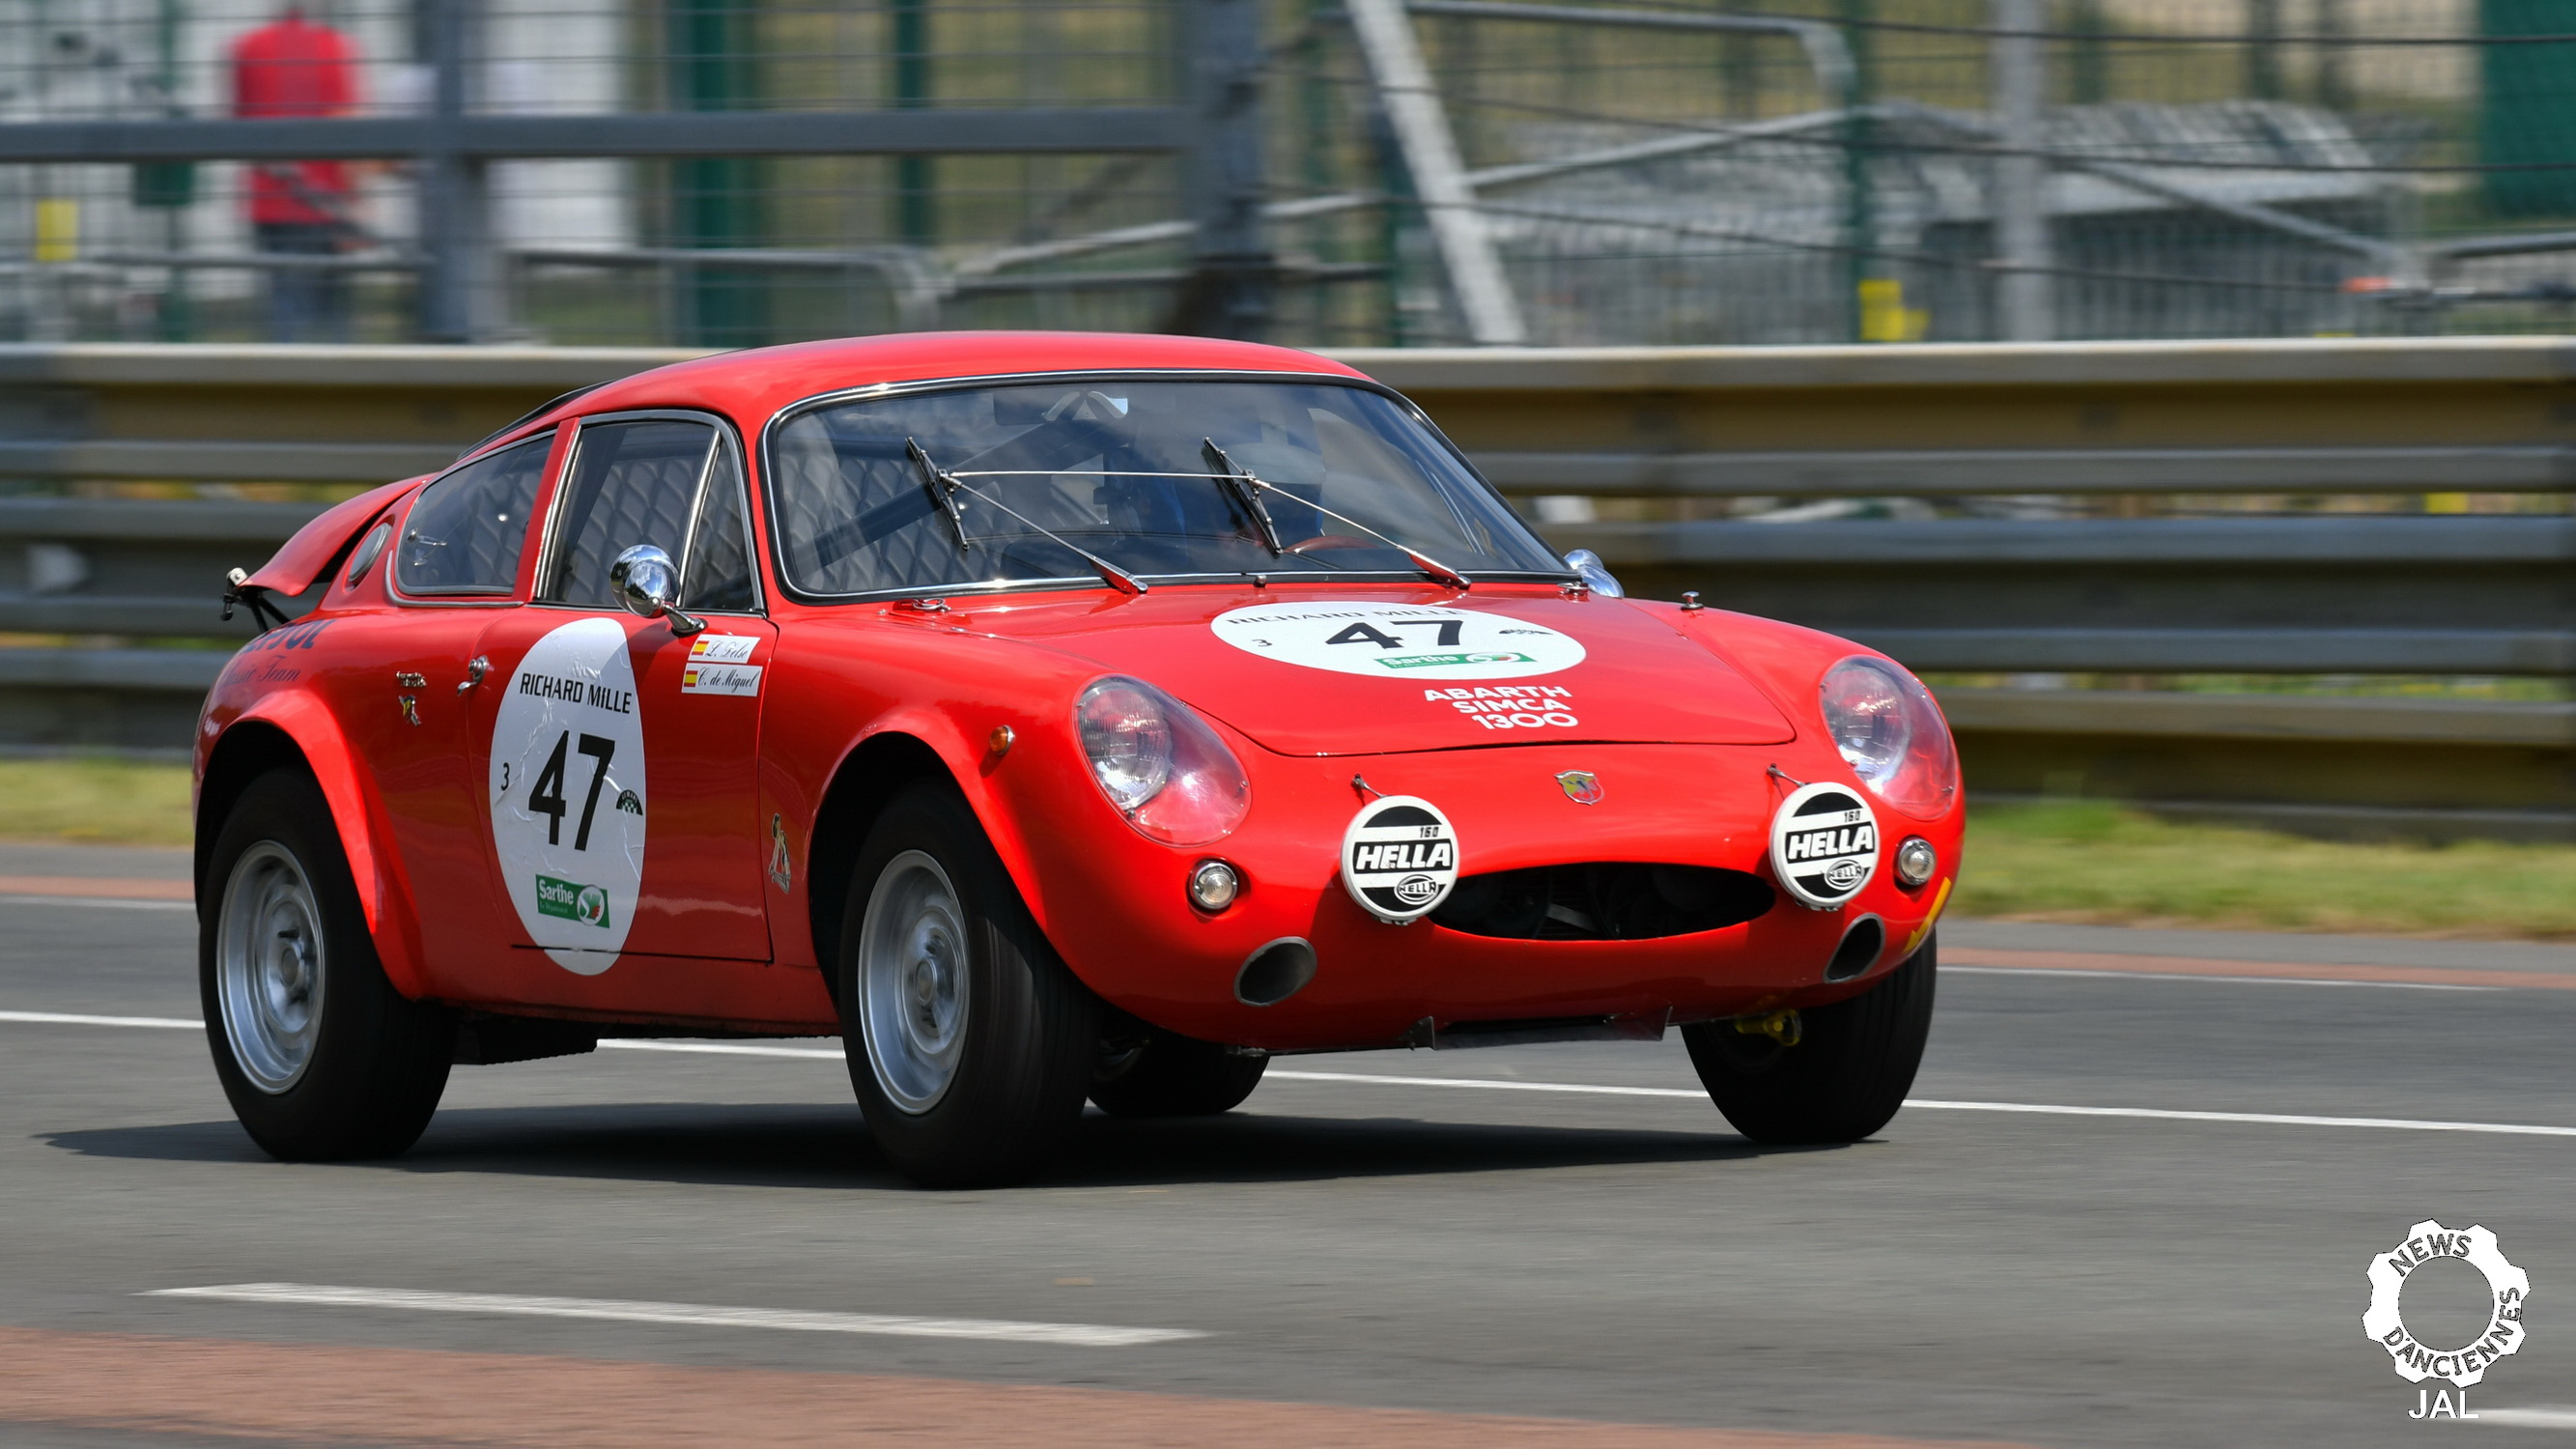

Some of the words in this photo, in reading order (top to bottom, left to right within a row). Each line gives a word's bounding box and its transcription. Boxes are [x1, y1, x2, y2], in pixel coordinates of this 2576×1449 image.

[1227, 611, 1366, 625] RICHARD
[1325, 619, 1464, 649] 47
[1252, 639, 1272, 647] 3
[1382, 655, 1458, 666] Sarthe
[710, 670, 722, 686] de
[722, 668, 760, 693] Miguel
[520, 672, 583, 703] RICHARD
[587, 684, 632, 714] MILLE
[1424, 686, 1573, 701] ABARTH
[1452, 698, 1572, 713] SIMCA
[1471, 712, 1579, 729] 1300
[500, 762, 510, 791] 3
[528, 730, 615, 851] 47
[1420, 826, 1439, 838] 160
[1787, 825, 1874, 860] HELLA
[1355, 842, 1451, 869] HELLA
[1828, 865, 1861, 879] HELLA
[538, 878, 574, 905] Sarthe
[1398, 880, 1436, 894] HELLA
